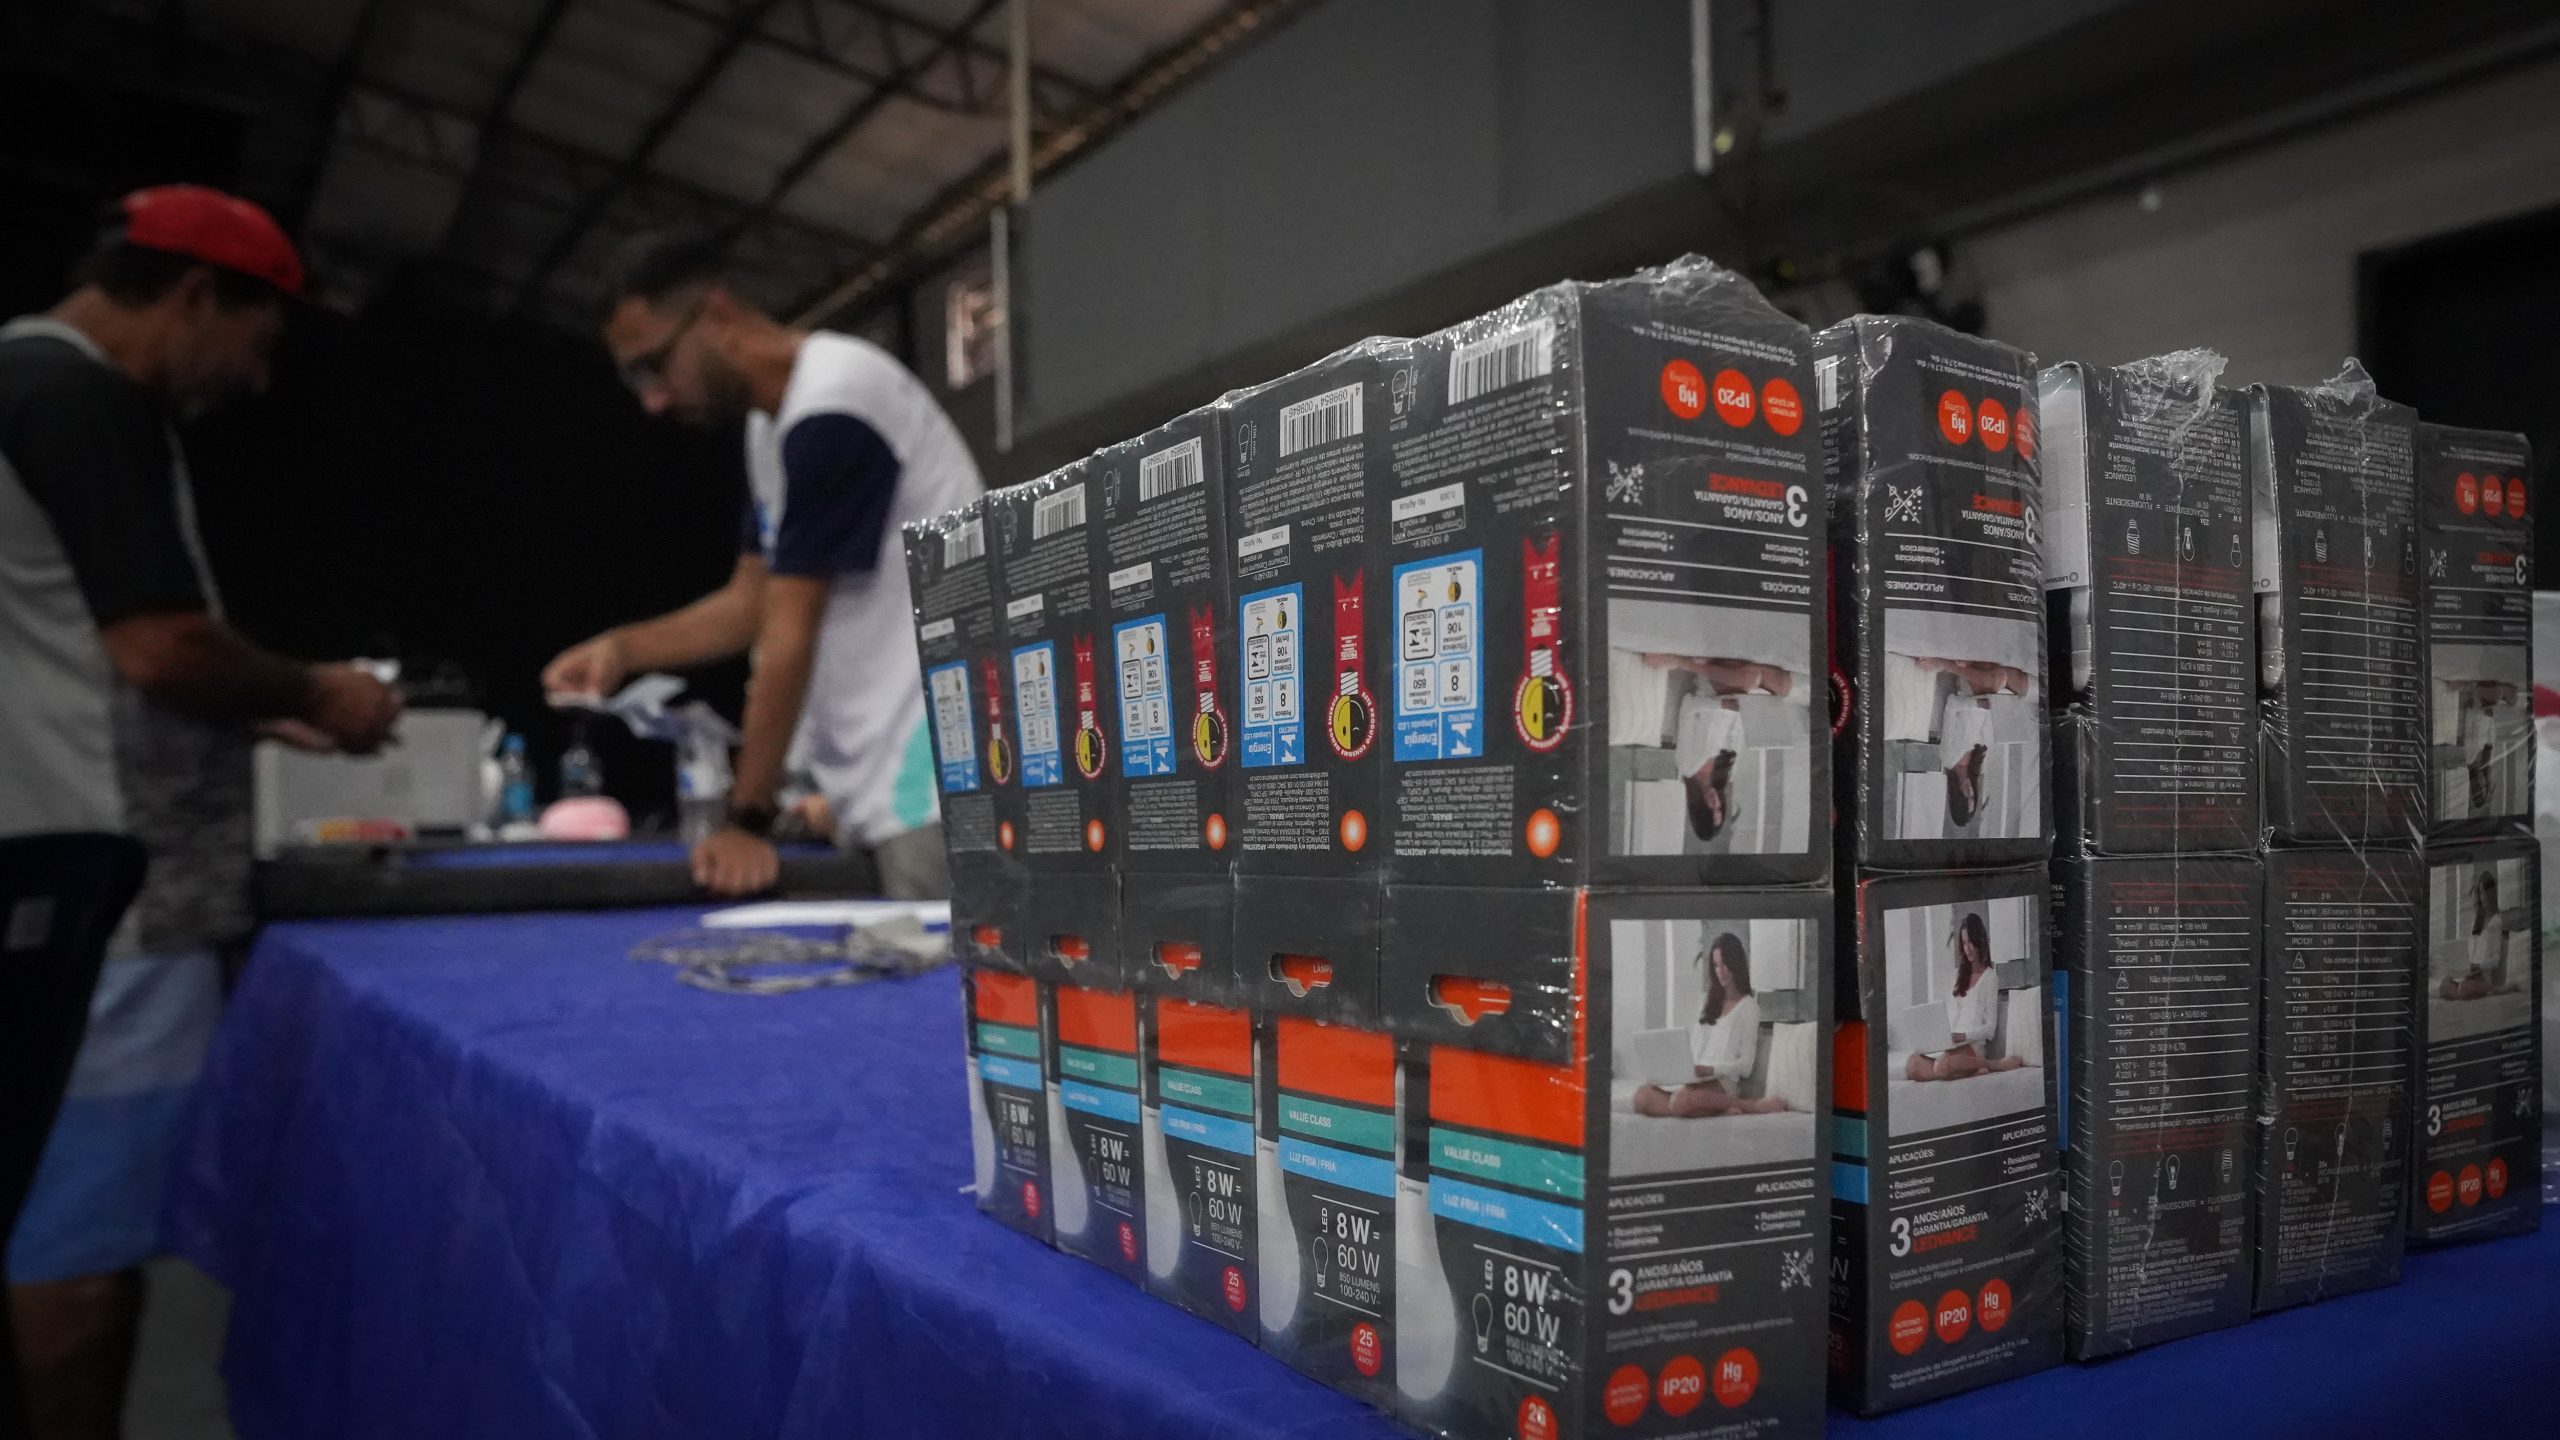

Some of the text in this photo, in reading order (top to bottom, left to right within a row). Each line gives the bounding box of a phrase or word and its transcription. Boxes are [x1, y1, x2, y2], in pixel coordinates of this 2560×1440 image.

[1320, 388, 1348, 406] 099854
[1356, 386, 1360, 396] 4
[1678, 384, 1697, 408] Hg
[1718, 387, 1750, 409] IP20
[1952, 414, 1966, 434] Hg
[1982, 415, 2005, 434] IP20
[2104, 471, 2136, 482] LEDVANCE
[1352, 490, 1364, 499] Não
[2106, 497, 2153, 510] FLUORESCENTE
[1336, 506, 1364, 518] Fabricado
[1723, 506, 1784, 524] ANOS/AÑOS
[1786, 485, 1808, 528] 3
[2296, 509, 2337, 521] FLUORESCENTE
[1962, 509, 2025, 530] GARANTIA/GARANTÍA
[2025, 506, 2035, 545] 3
[1351, 535, 1364, 543] Tipo
[1983, 524, 2025, 542] ANOS/AÑOS
[1900, 544, 1940, 556] Comercios
[1895, 553, 1940, 566] Residencias
[2515, 554, 2526, 585] 3
[1884, 580, 1944, 593] APLICACIONES:
[1447, 622, 1462, 634] 106
[1277, 646, 1288, 656] 106
[1451, 675, 1459, 692] 8
[1281, 693, 1286, 707] 8
[1362, 692, 1372, 705] ESTE
[1153, 710, 1158, 723] 8
[1366, 708, 1375, 744] PRODUTO
[1341, 744, 1366, 757] CONSOME
[2126, 1013, 2134, 1021] Hz
[1168, 1080, 1202, 1096] VALUE CLASS
[1289, 1110, 1332, 1128] VALUE CLASS
[2427, 1104, 2441, 1136] 3
[2002, 1124, 2046, 1142] APLICACIONES:
[1289, 1151, 1337, 1173] LUZ FRIA FRIA
[1444, 1144, 1502, 1169] VALUE CLASS
[1889, 1149, 1935, 1165] APLICAÇÕES:
[1894, 1186, 1931, 1200] Comercios
[2461, 1178, 2480, 1192] IP20
[1442, 1192, 1459, 1206] LUZ
[1913, 1204, 1966, 1225] ANOS/AÑOS
[1913, 1212, 1989, 1237] GARANTIA/GARANTÍA
[1890, 1217, 1911, 1258] 3
[1484, 1258, 1494, 1290] LED
[1636, 1258, 1704, 1280] ANOS/AÑOS
[1228, 1271, 1239, 1286] 25
[1338, 1272, 1381, 1294] 850 LUMENS
[1339, 1283, 1370, 1303] 100-240
[1608, 1268, 1634, 1316] 3
[1985, 1292, 1999, 1310] Hg
[1940, 1307, 1968, 1327] IP20
[1359, 1328, 1373, 1348] 25
[1723, 1362, 1744, 1382] Hg
[1664, 1376, 1700, 1396] IP20
